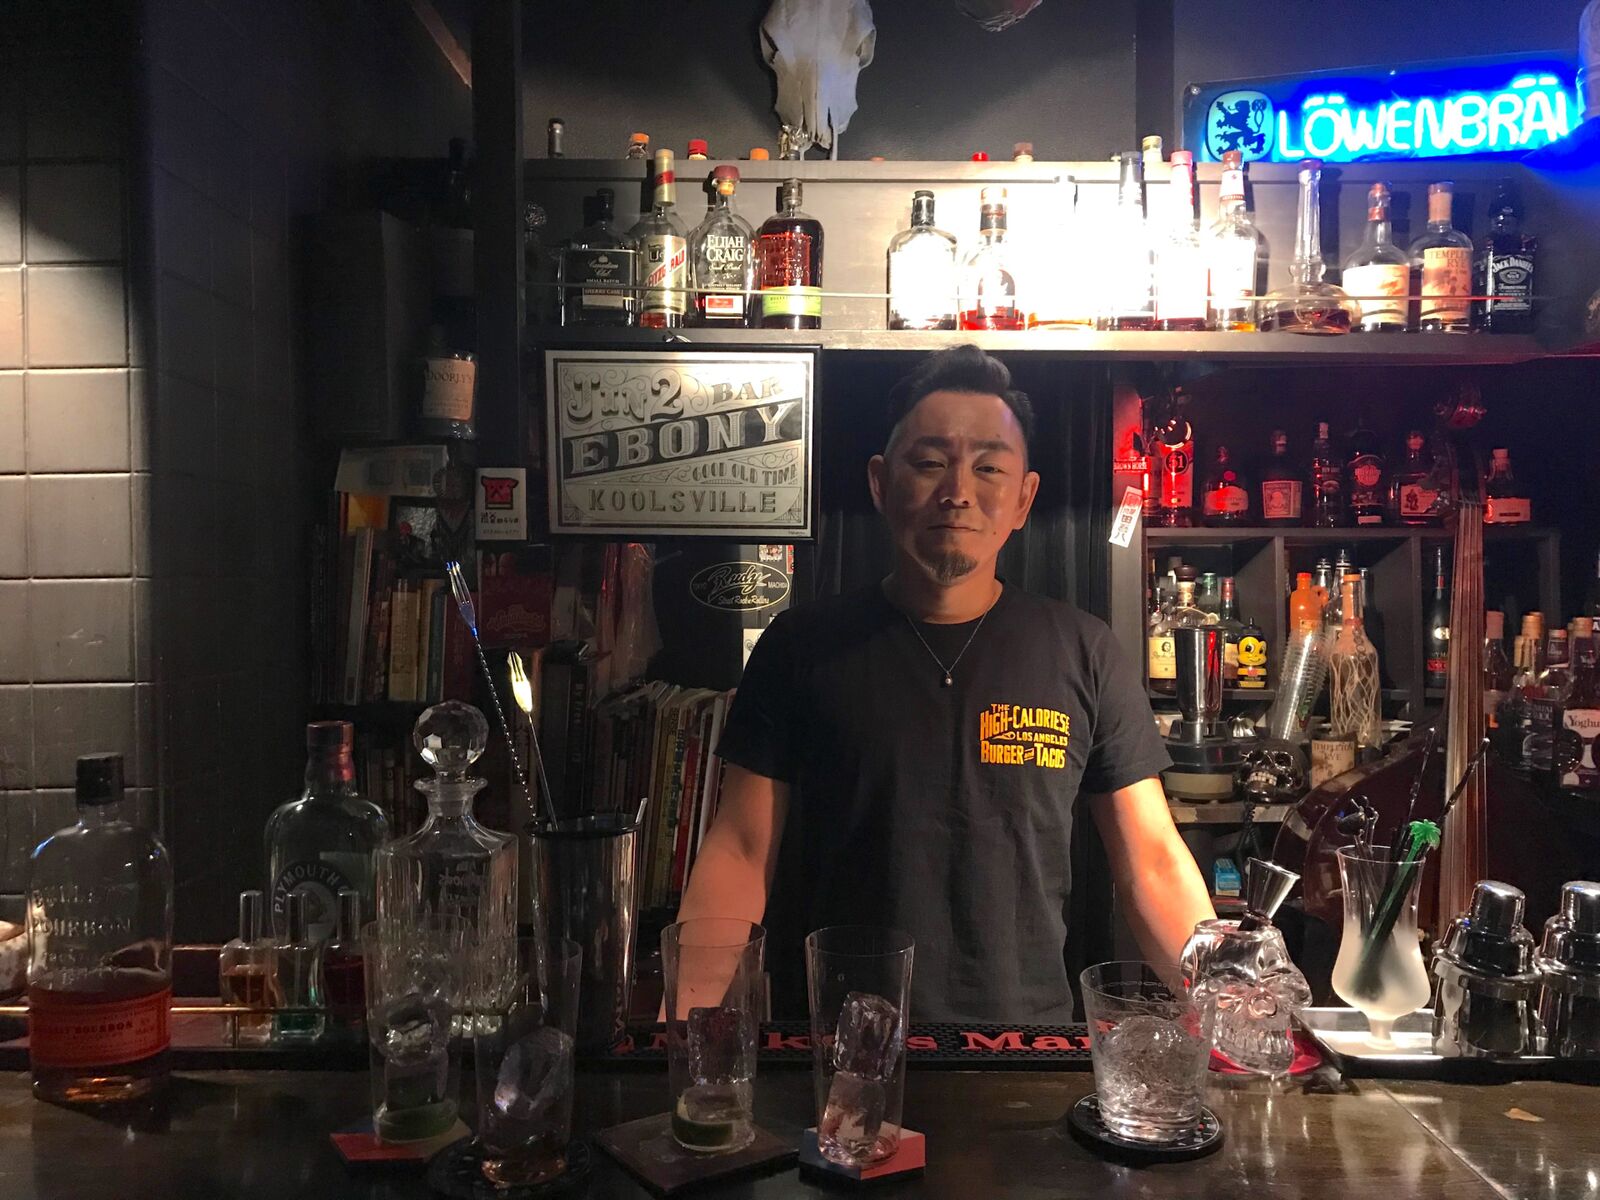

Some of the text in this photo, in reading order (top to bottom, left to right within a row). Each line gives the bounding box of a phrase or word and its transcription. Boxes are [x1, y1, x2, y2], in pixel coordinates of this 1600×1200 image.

[707, 234, 744, 249] ELIJAH
[706, 247, 744, 263] CRAIG
[711, 376, 784, 404] BAR
[570, 401, 796, 474] EBONY
[731, 463, 758, 484] OLD
[588, 488, 777, 513] KOOLSVILLE
[991, 703, 1010, 713] THE
[980, 705, 1067, 741] HIGH-CALORIES
[1016, 731, 1068, 747] LOS ANGELES
[980, 740, 1024, 765] BURGER
[1034, 742, 1066, 769] TACOS
[274, 863, 341, 914] PLYMOUTH
